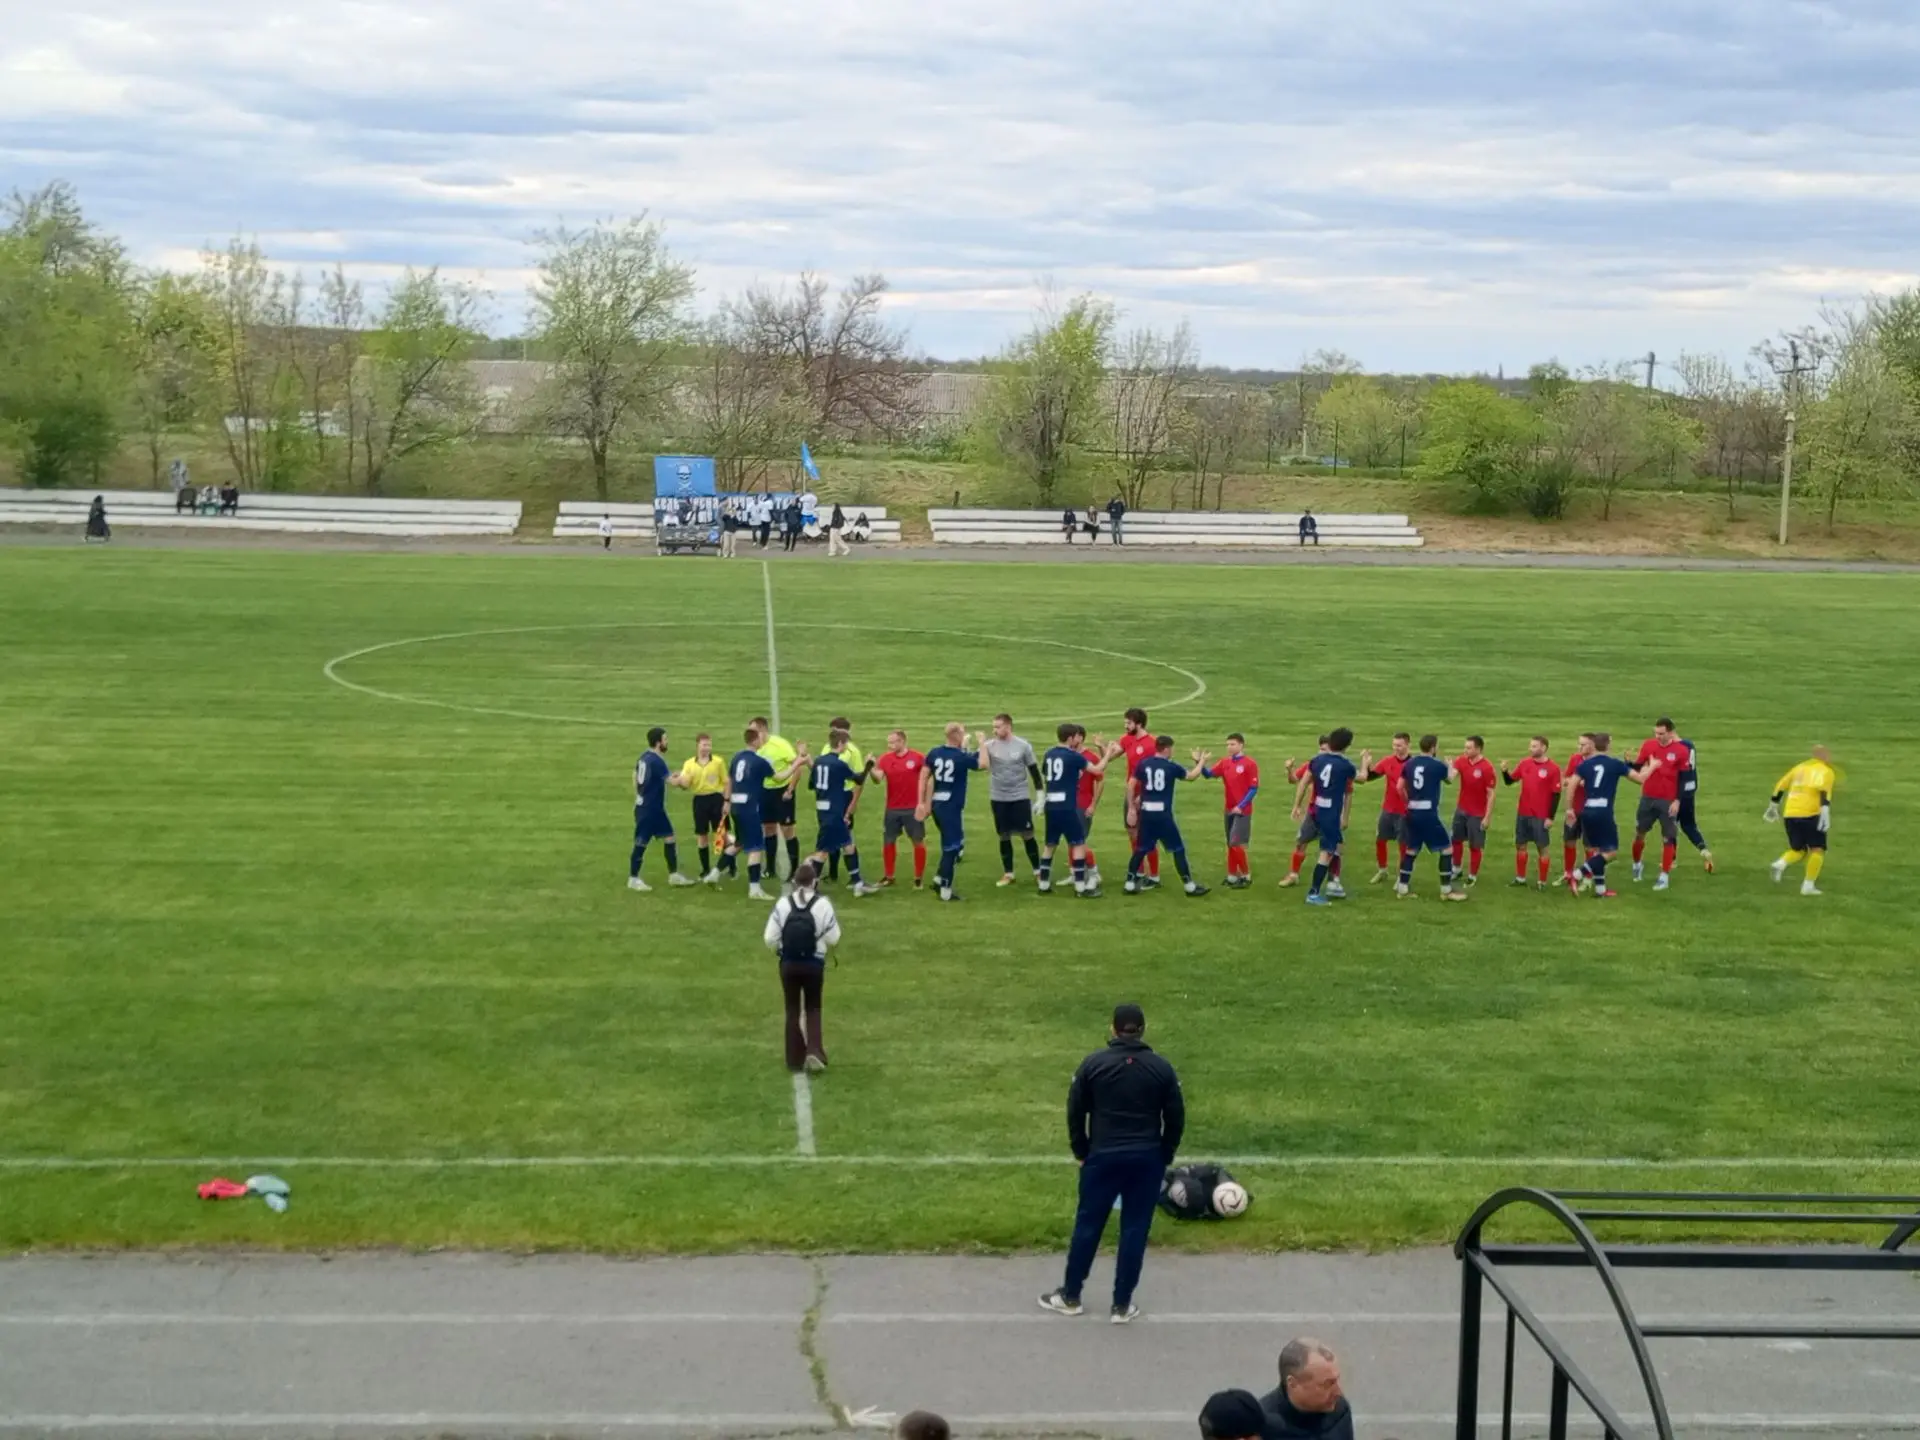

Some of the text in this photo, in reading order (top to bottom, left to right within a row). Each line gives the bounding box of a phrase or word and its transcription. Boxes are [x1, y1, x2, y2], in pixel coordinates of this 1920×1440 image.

[816, 765, 829, 790] 11
[934, 758, 955, 783] 22
[1046, 757, 1064, 781] 19
[1145, 766, 1166, 791] 18
[1320, 763, 1332, 788] 4
[1413, 765, 1425, 790] 5
[1594, 764, 1605, 788] 7
